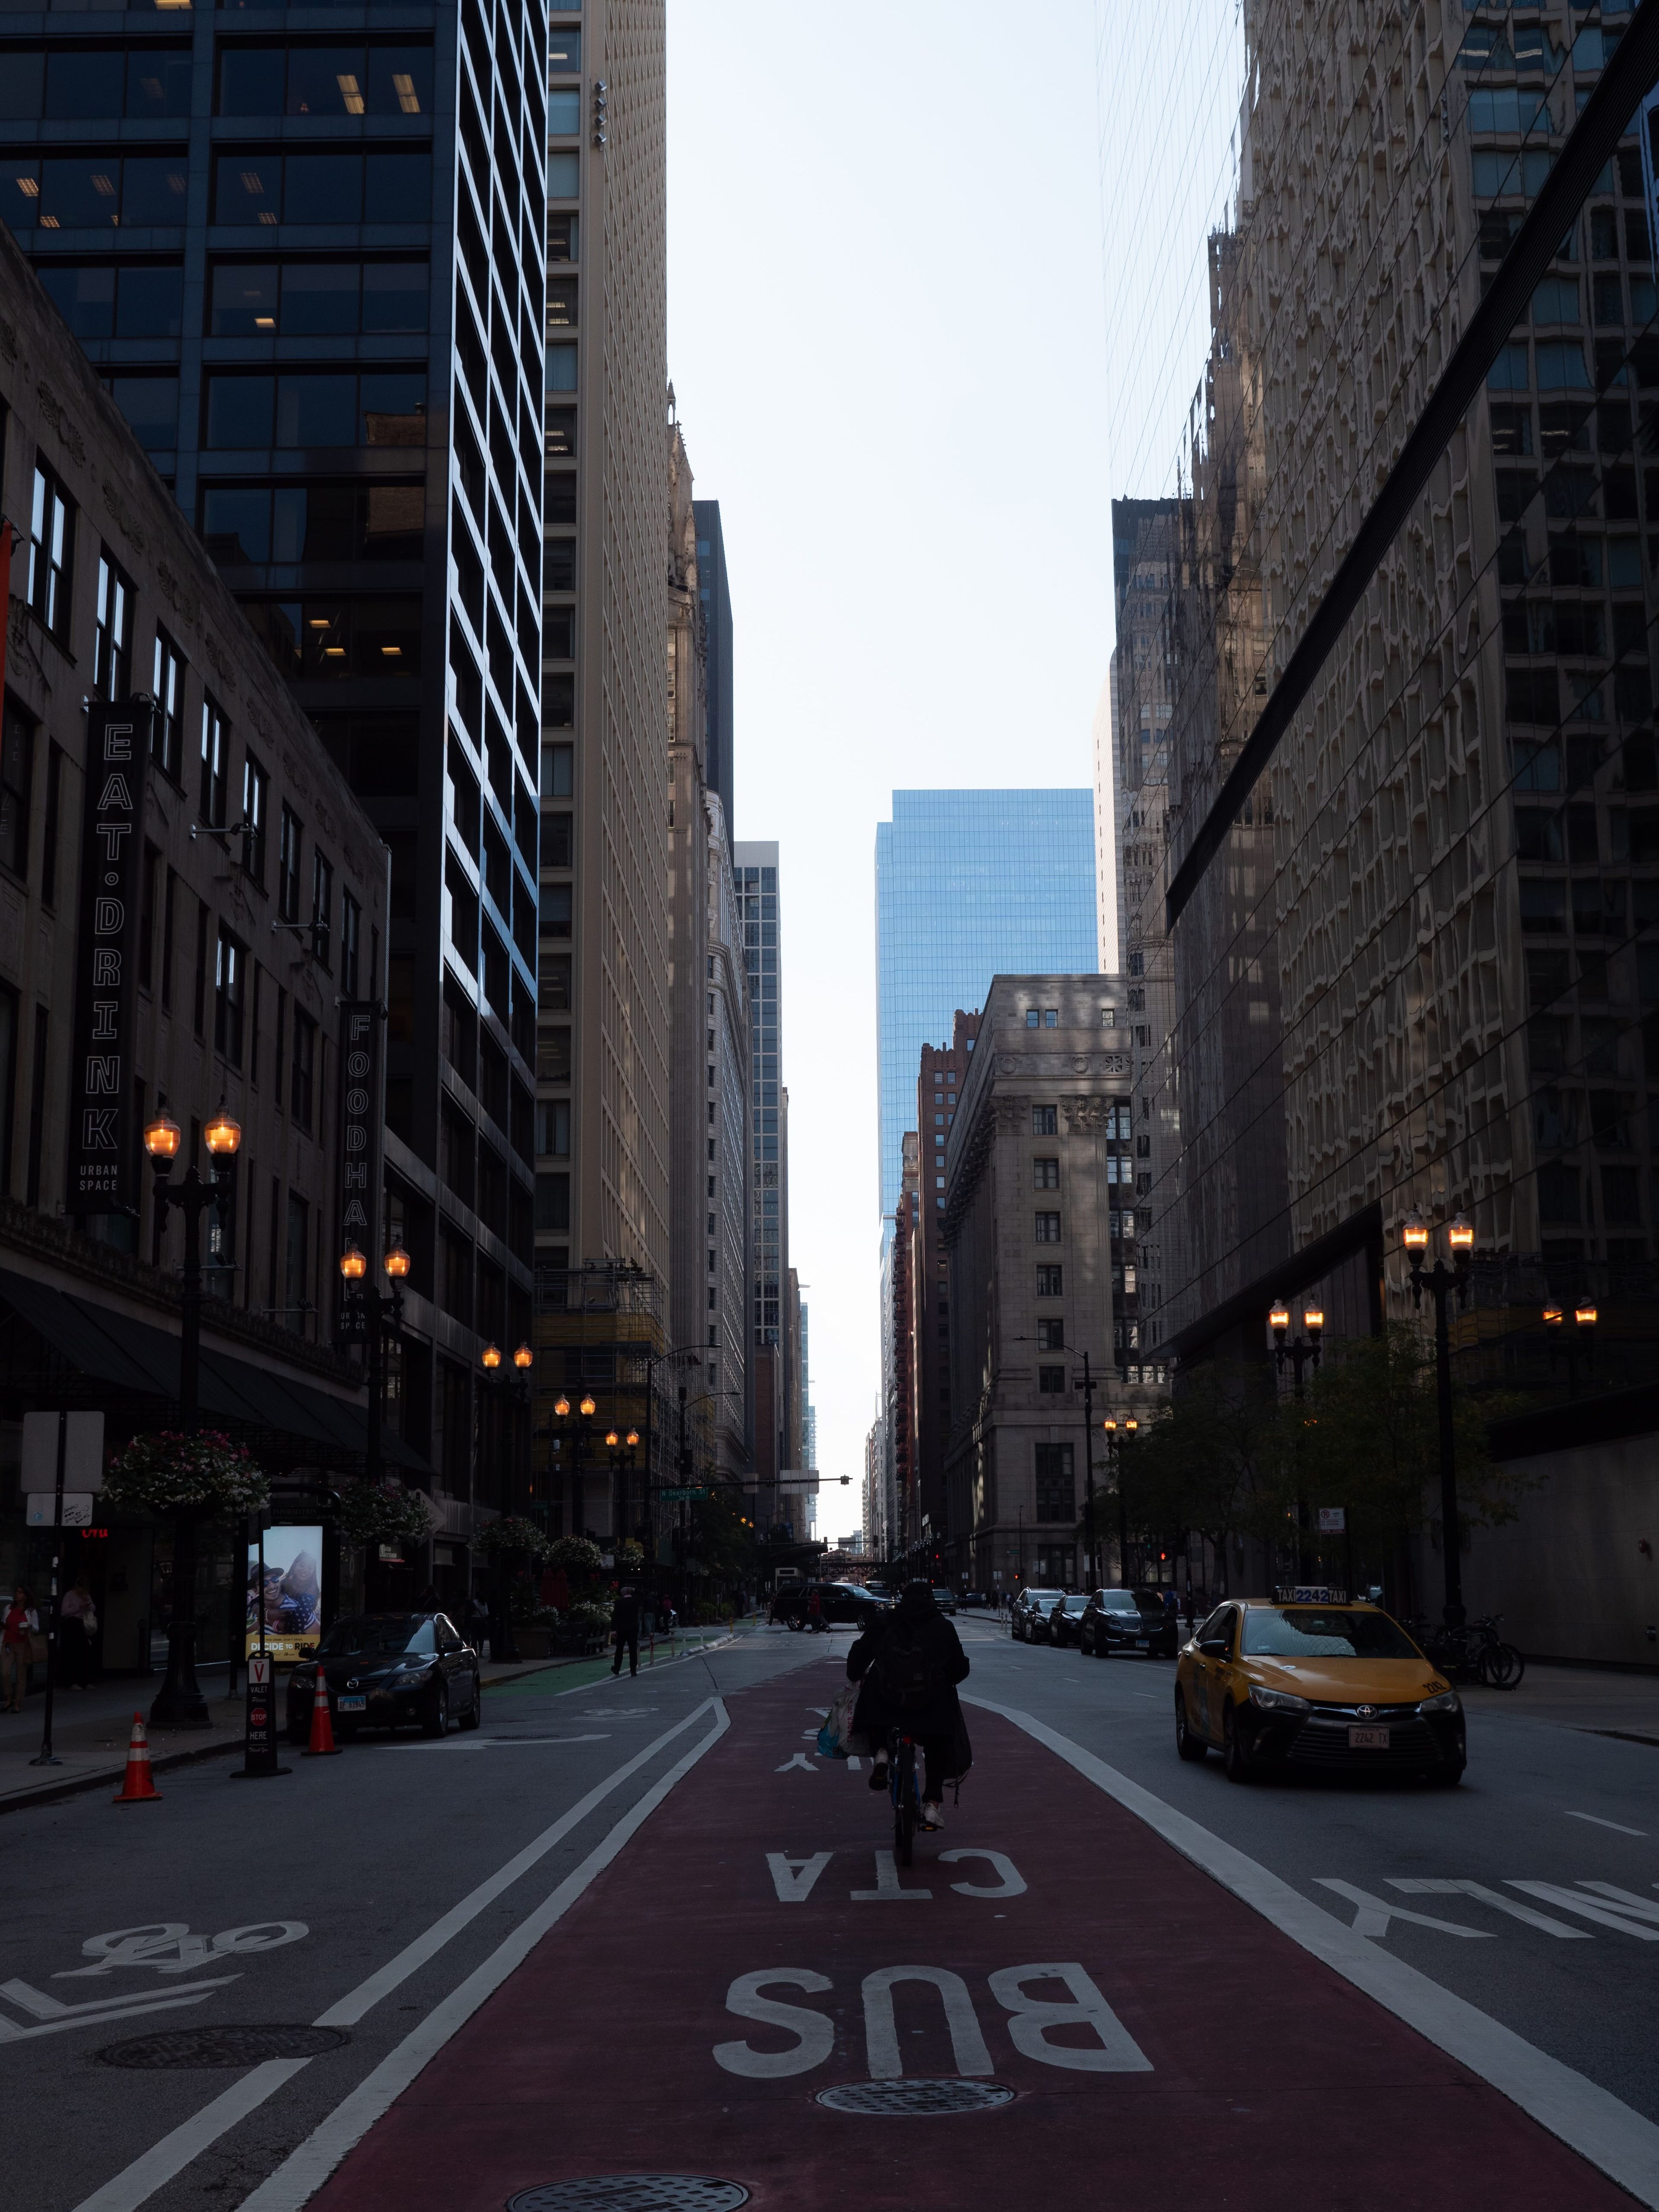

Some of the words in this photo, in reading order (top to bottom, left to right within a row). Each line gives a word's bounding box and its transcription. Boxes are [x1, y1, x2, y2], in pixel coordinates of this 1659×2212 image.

[79, 1165, 118, 1176] URBAN
[79, 1179, 117, 1191] SPACE
[340, 1322, 365, 1330] SPCE
[1278, 1589, 1296, 1602] TAXI
[1296, 1589, 1328, 1602] 2242
[1328, 1590, 1347, 1603] TAXI
[1422, 1681, 1446, 1694] 2242
[250, 1731, 267, 1740] HERE
[1355, 1733, 1374, 1743] 2242
[1379, 1733, 1387, 1744] TX
[765, 1848, 1027, 1902] CTA
[1312, 1877, 1659, 1940] NLY
[712, 1962, 1154, 2079] BUS
